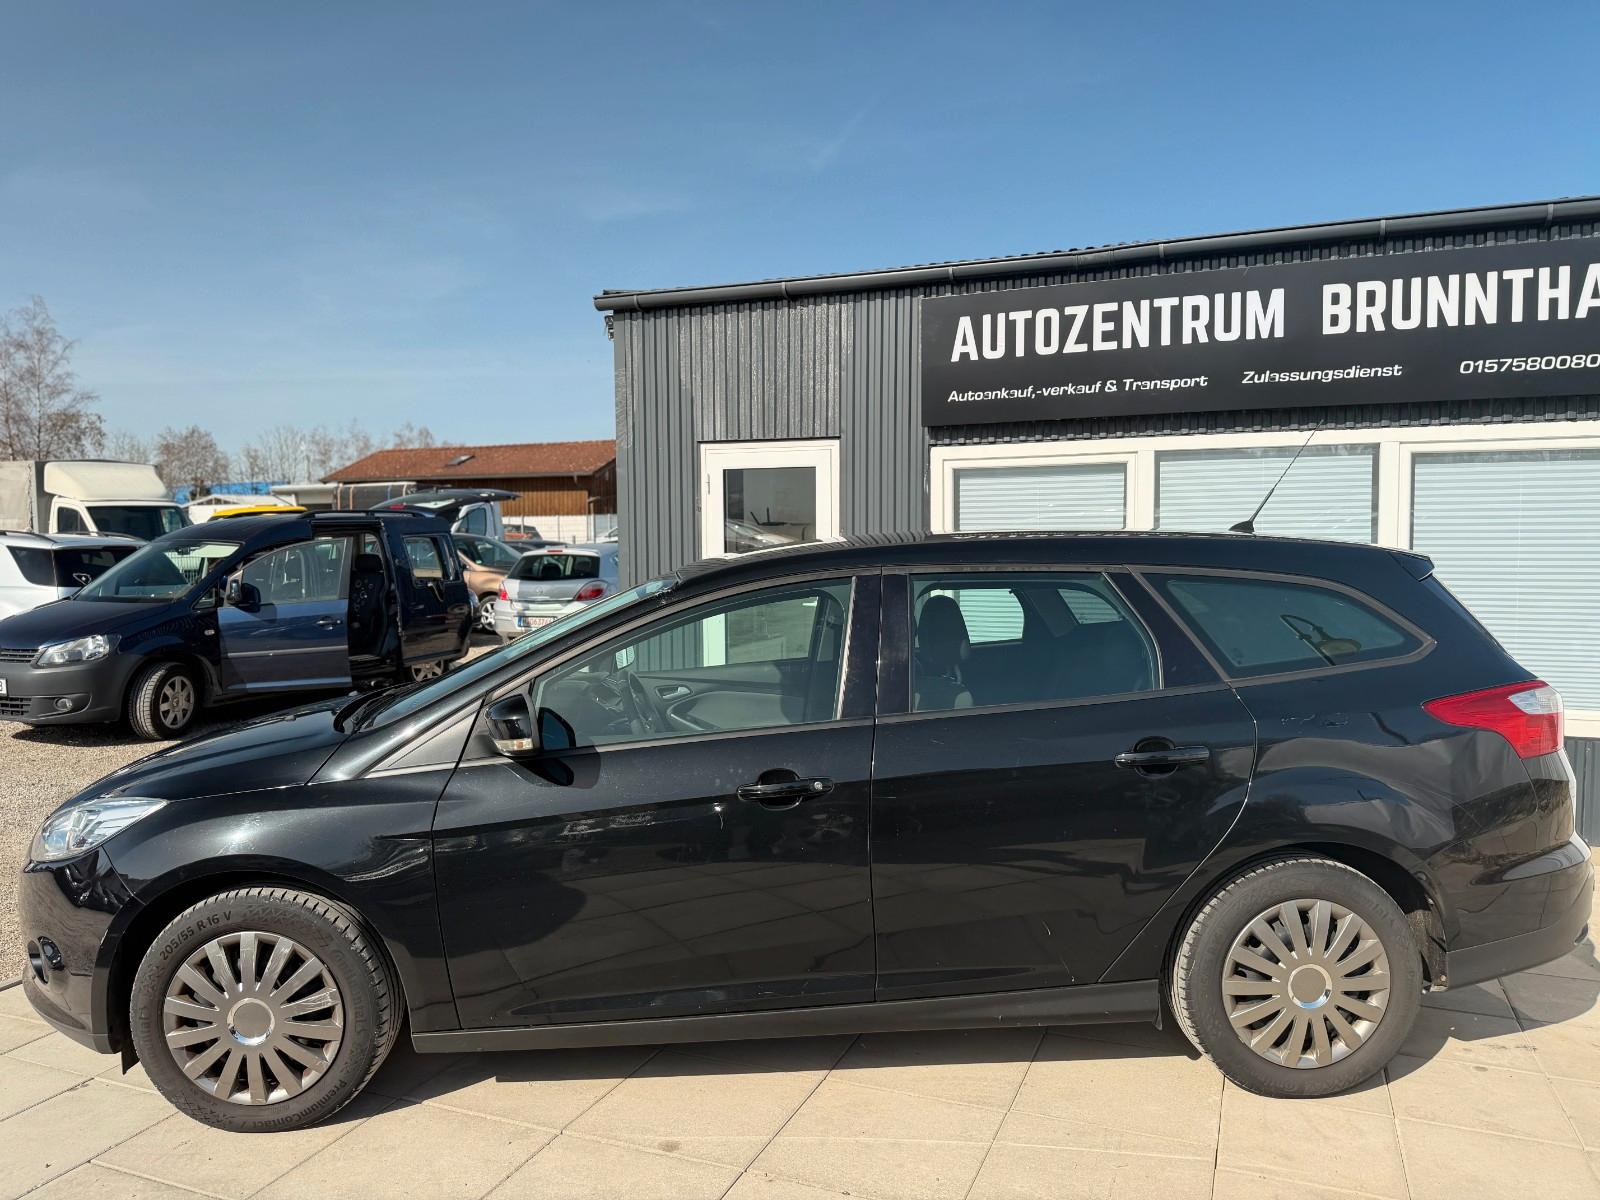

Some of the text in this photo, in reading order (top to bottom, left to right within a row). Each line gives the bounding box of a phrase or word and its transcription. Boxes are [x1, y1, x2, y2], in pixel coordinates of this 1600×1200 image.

[950, 263, 1600, 363] AUTOZENTRUM BRUNNTHA
[1241, 364, 1402, 384] Zulassungsdienst
[1459, 353, 1600, 374] 0157580080
[947, 380, 1102, 402] Autoankauf,-verkauf
[1122, 375, 1209, 391] Transport
[160, 926, 194, 960] 205/55
[223, 911, 232, 921] V
